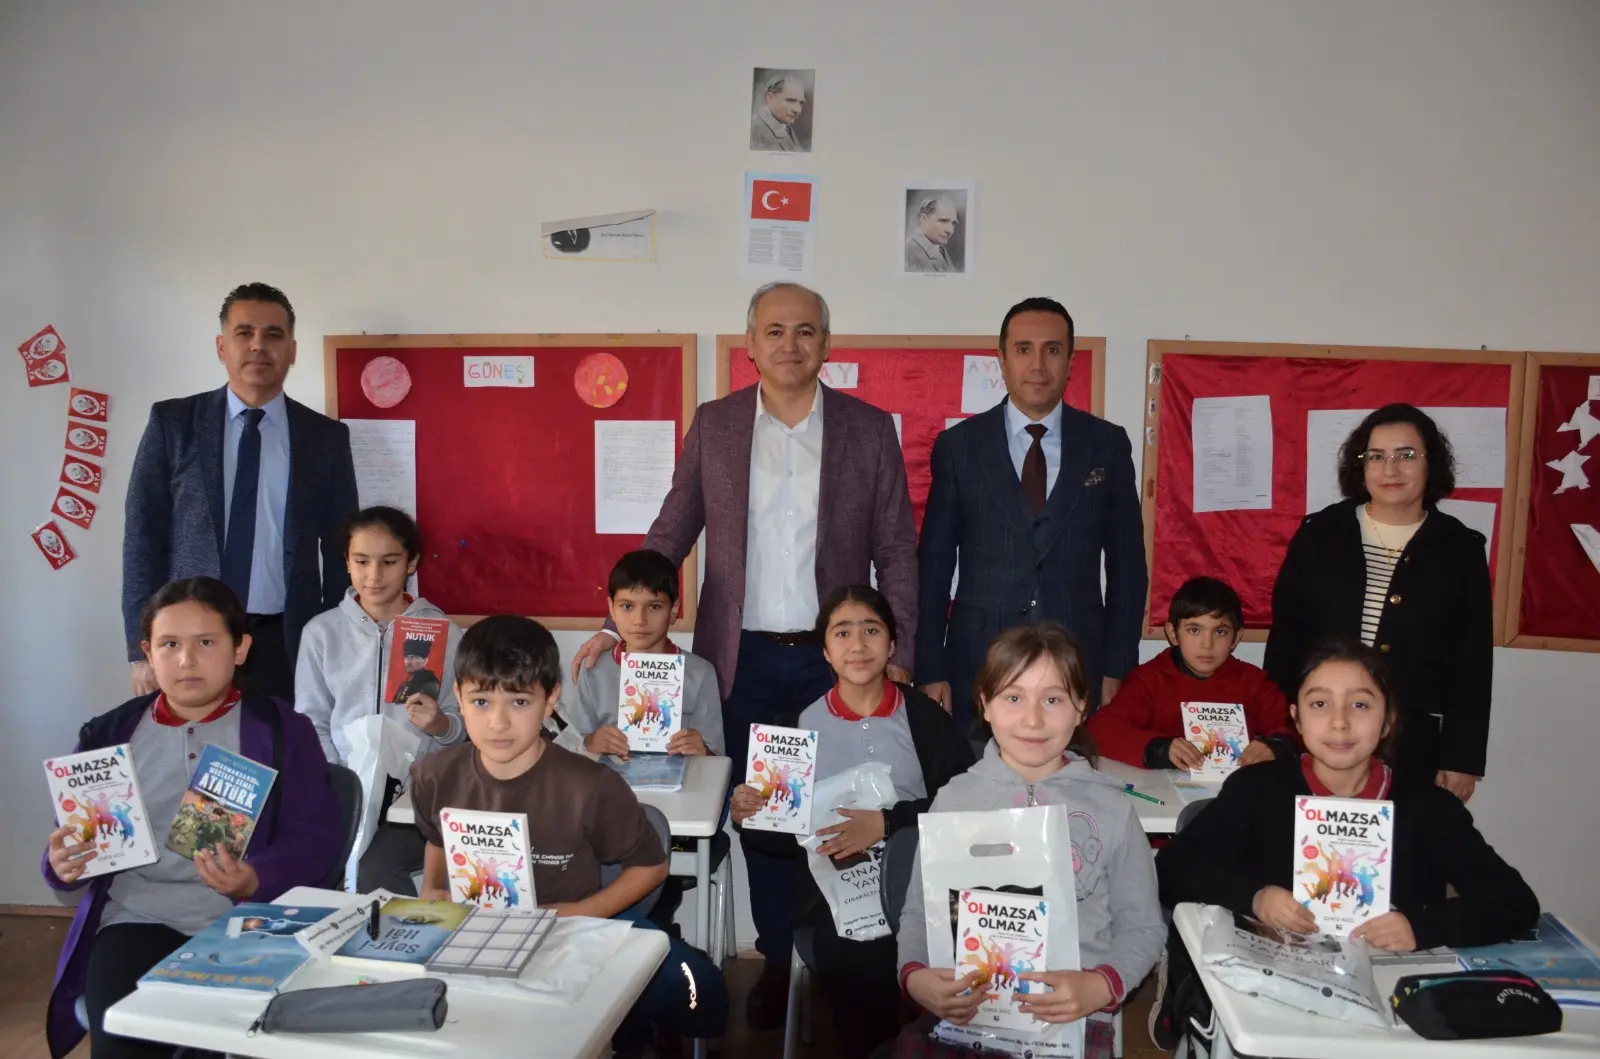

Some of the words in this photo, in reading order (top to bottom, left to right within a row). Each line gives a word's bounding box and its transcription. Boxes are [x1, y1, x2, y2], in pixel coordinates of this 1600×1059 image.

[468, 361, 526, 384] GÜNEŞ
[820, 363, 853, 385] AY
[406, 631, 435, 641] NUTUK
[627, 660, 676, 671] OLMAZSA
[635, 670, 668, 680] OLMAZ
[1188, 706, 1237, 715] OLMAZSA
[1197, 714, 1231, 722] OLMAZ
[756, 732, 809, 748] OLMAZSA
[764, 744, 800, 757] OLMAZ
[54, 756, 119, 778] OLMAZSA
[68, 771, 112, 788] OLMAZ
[235, 777, 255, 791] KEMAL
[1305, 808, 1380, 826] OLMAZSA
[450, 821, 513, 837] OLMAZSA
[1317, 823, 1368, 839] OLMAZ
[461, 835, 504, 848] OLMAZ
[968, 902, 1037, 921] OLMAZSA
[978, 917, 1026, 933] OLMAZ
[359, 940, 420, 954] Seyr-i
